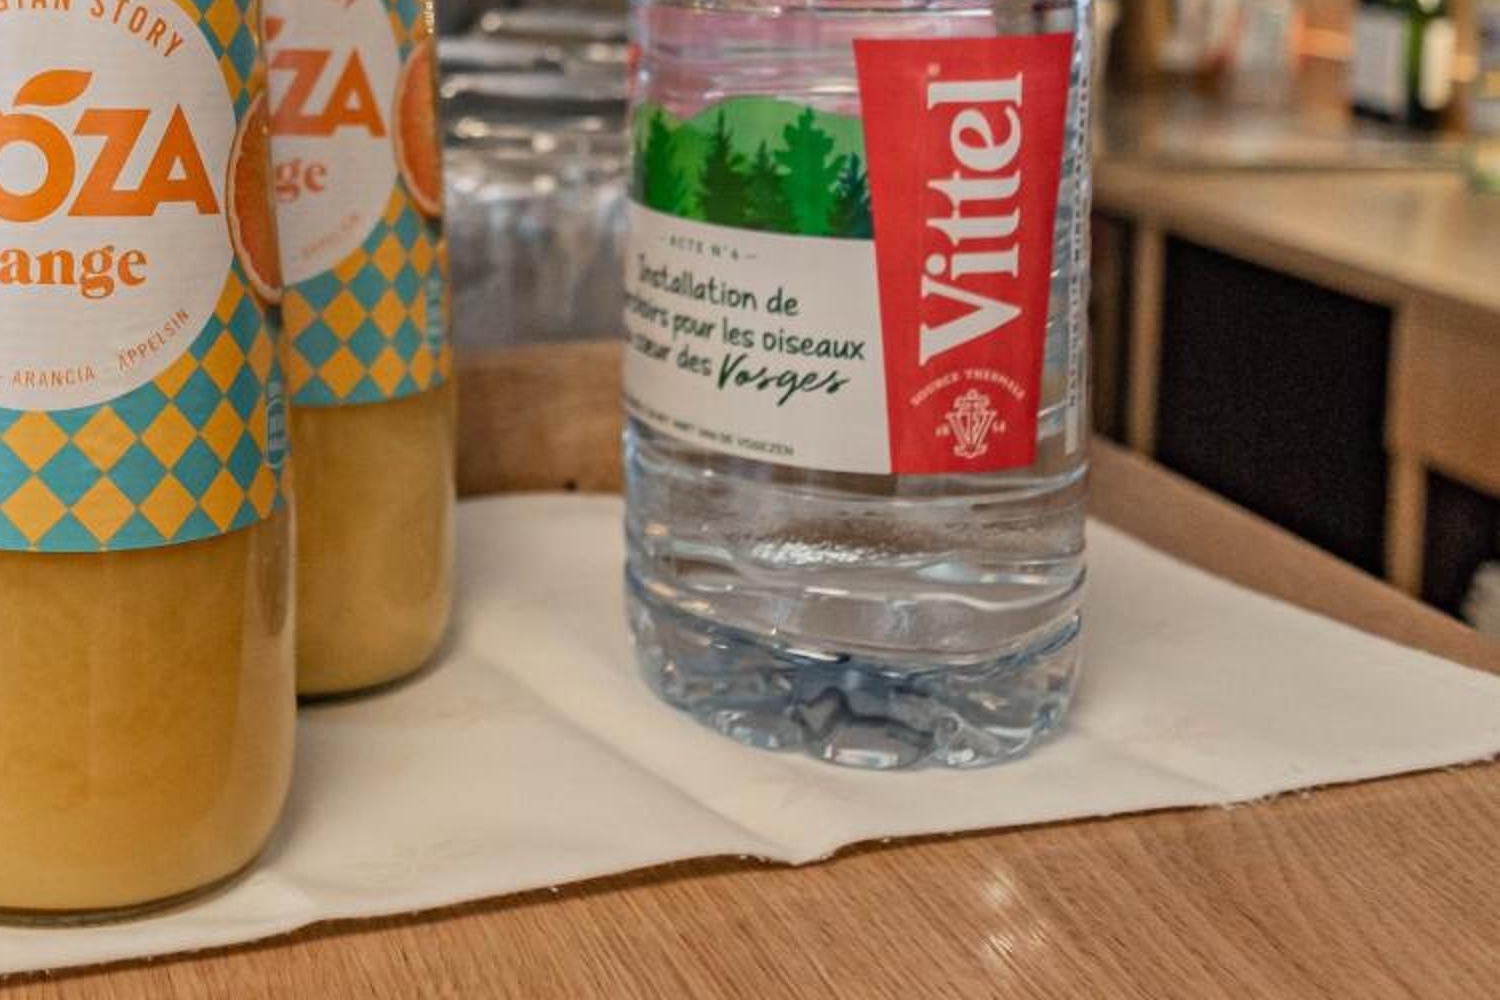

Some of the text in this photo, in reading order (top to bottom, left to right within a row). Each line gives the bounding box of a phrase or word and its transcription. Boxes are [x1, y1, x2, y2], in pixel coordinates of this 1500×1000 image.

[918, 72, 1023, 367] Vittel
[766, 286, 799, 317] de
[672, 312, 715, 340] pour
[722, 316, 755, 349] les
[762, 328, 866, 361] oiseaux
[11, 364, 96, 389] ARANCIA
[676, 344, 713, 377] des
[717, 352, 850, 407] Vosges
